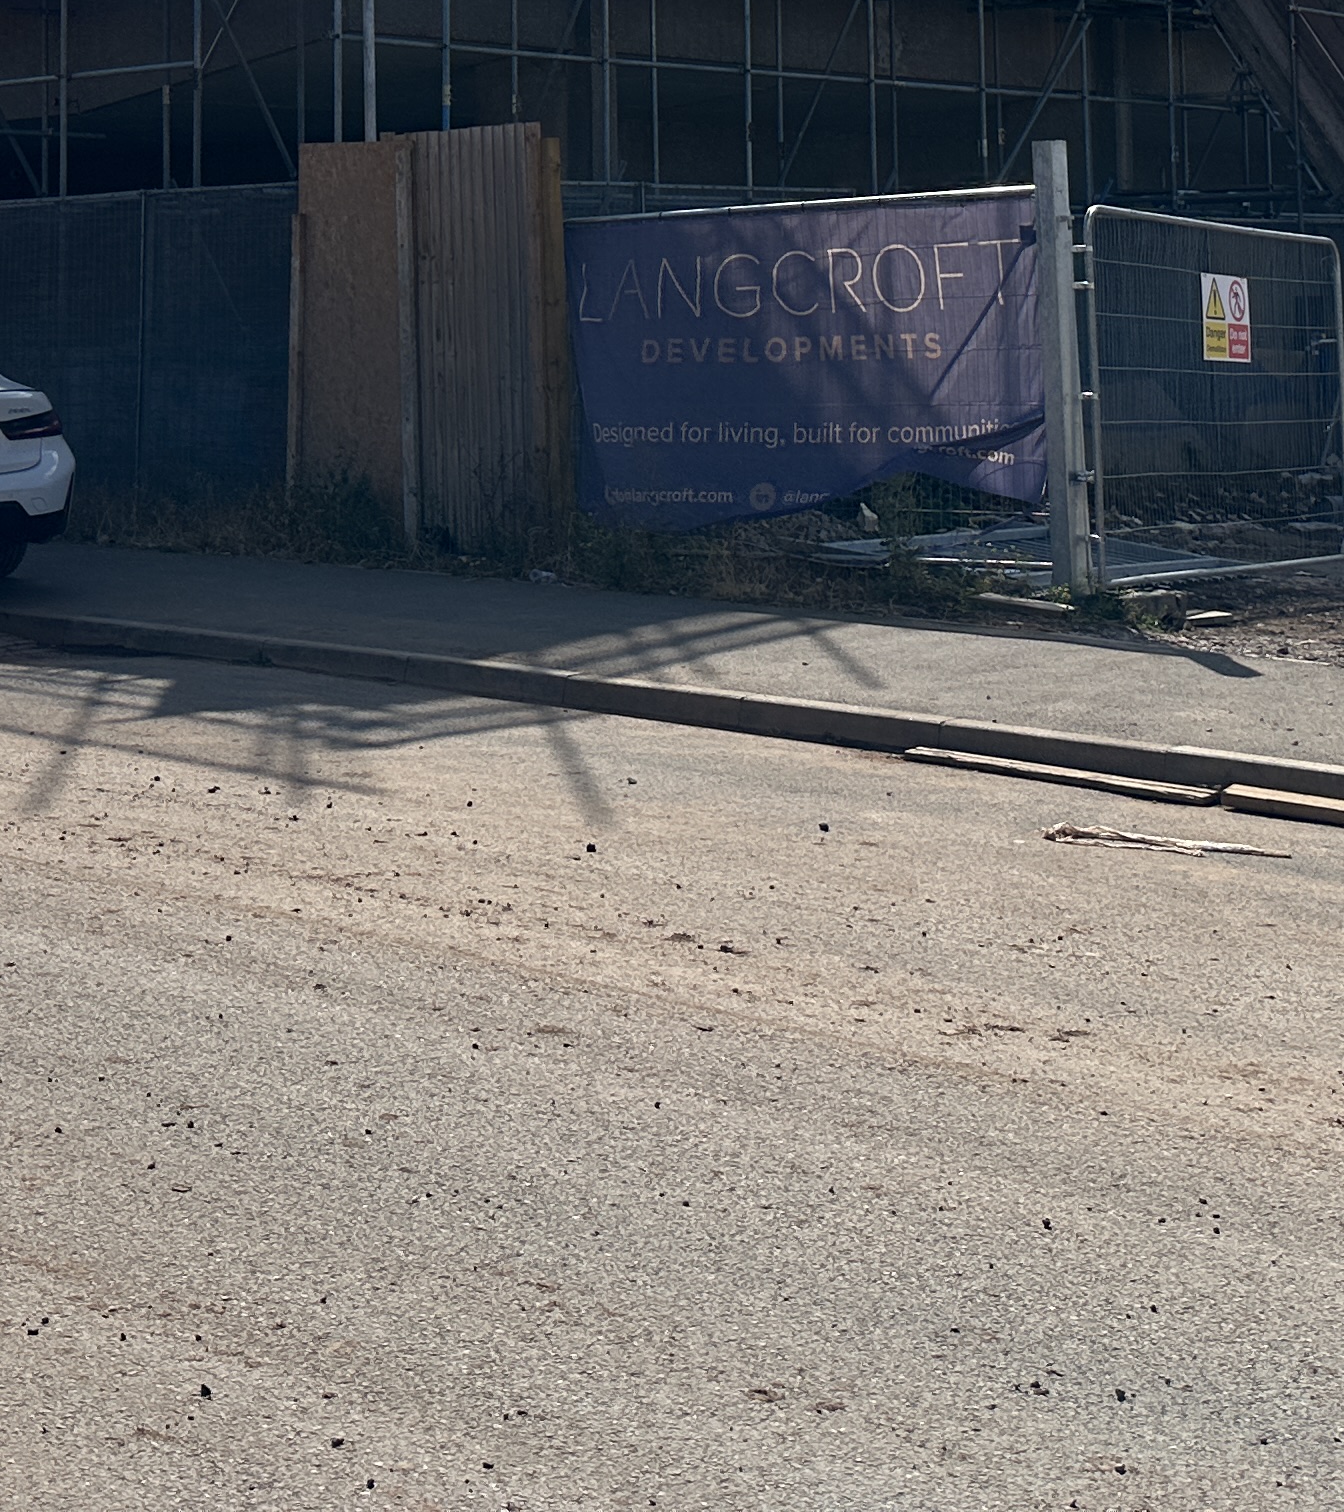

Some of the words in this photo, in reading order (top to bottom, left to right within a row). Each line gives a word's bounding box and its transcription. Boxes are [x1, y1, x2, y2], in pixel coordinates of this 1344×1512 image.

[578, 238, 1020, 323] LANGCROFT
[1206, 326, 1226, 341] Danger
[1229, 327, 1238, 340] Do
[1238, 329, 1248, 341] not
[641, 332, 942, 364] DEVELOPMENTS
[1231, 344, 1247, 354] enter
[593, 422, 674, 448] Designed
[680, 421, 710, 443] for
[718, 420, 786, 448] living,
[792, 420, 843, 444] built
[848, 420, 881, 444] for
